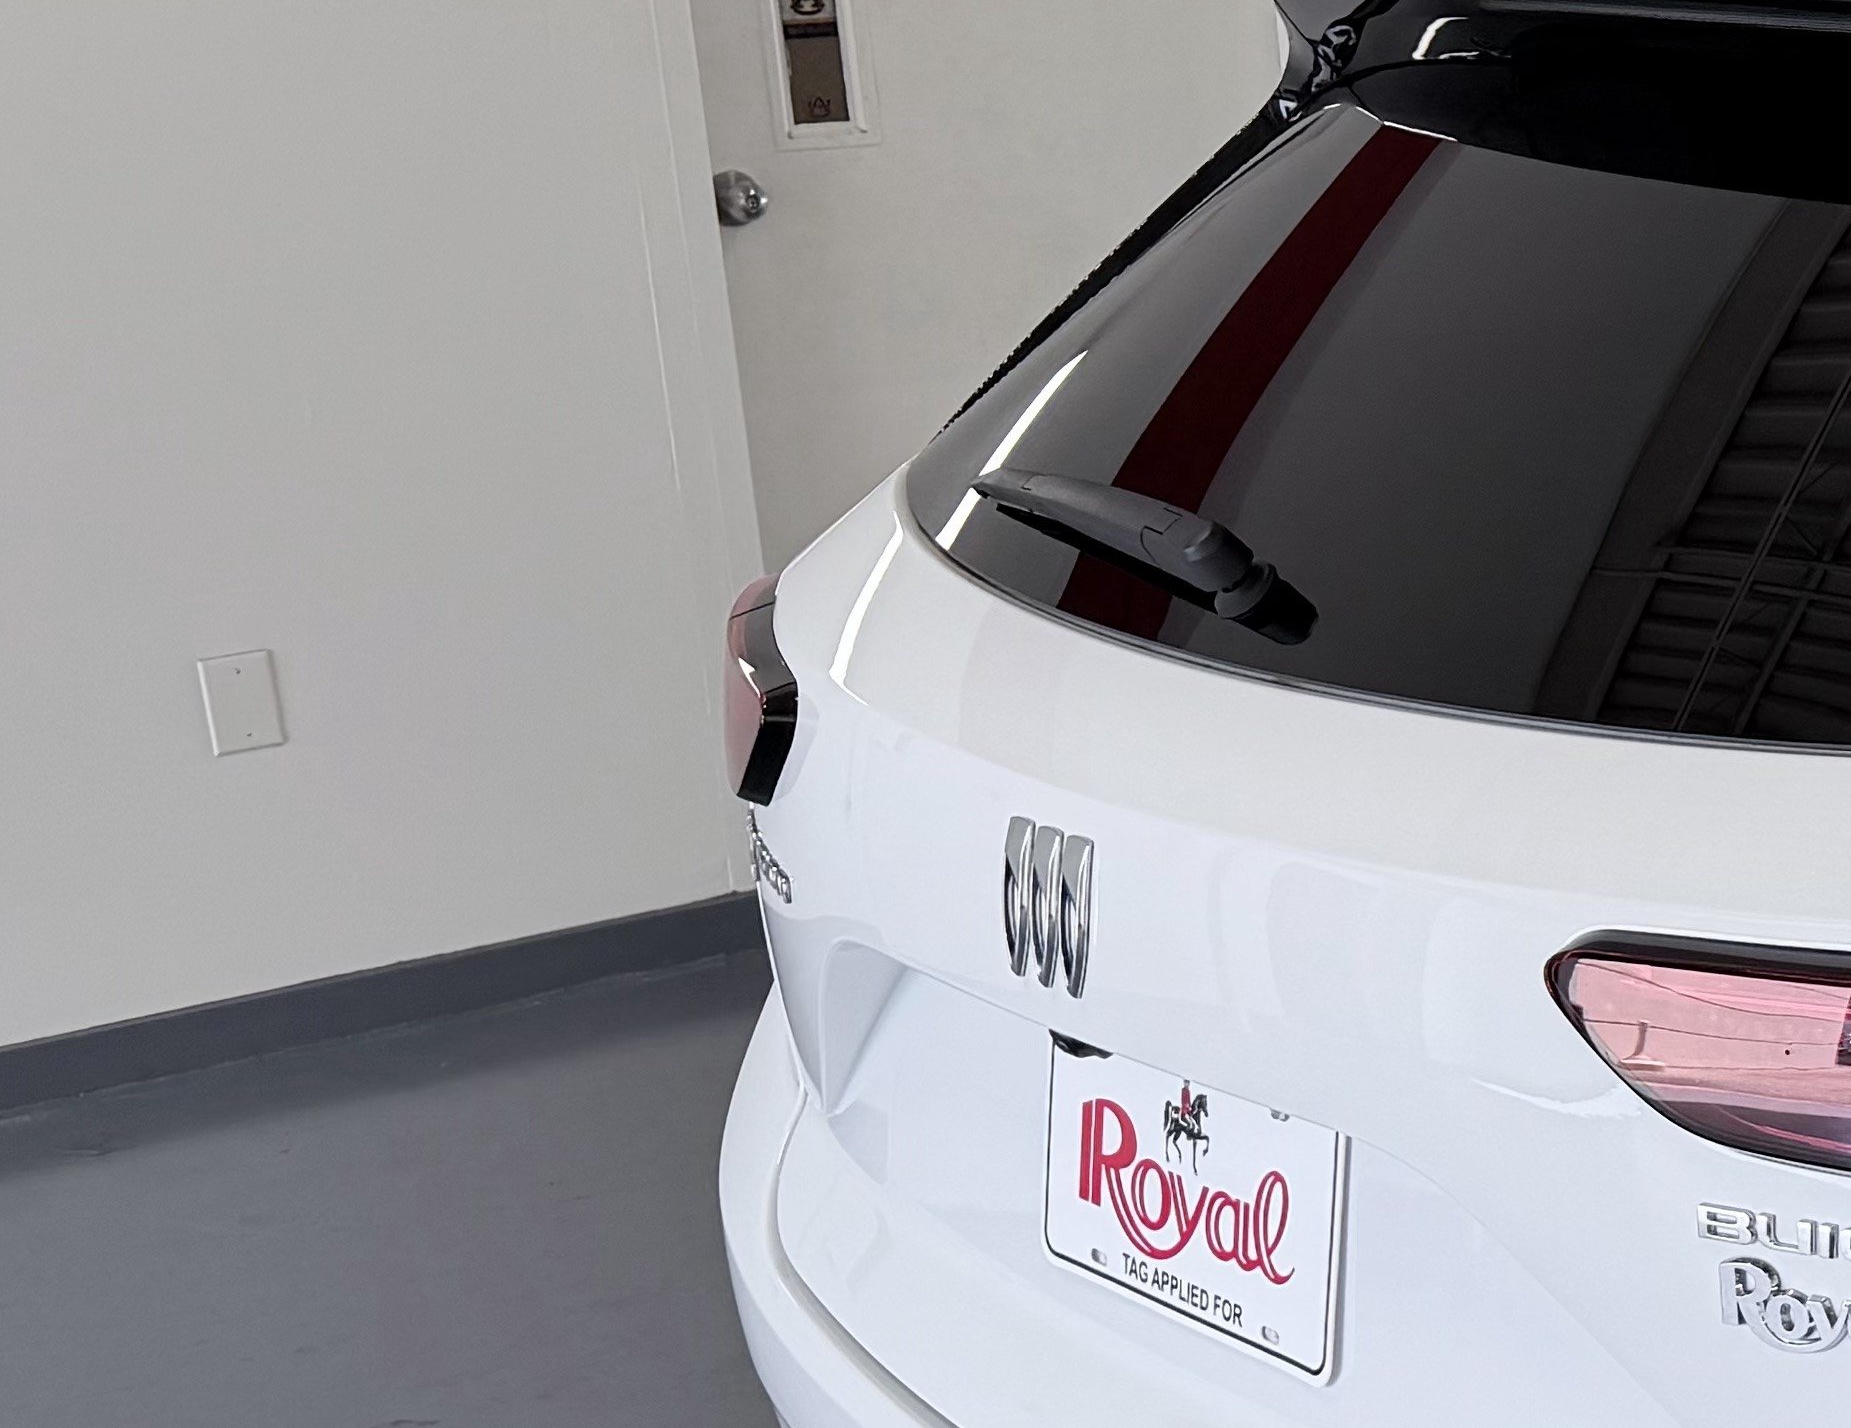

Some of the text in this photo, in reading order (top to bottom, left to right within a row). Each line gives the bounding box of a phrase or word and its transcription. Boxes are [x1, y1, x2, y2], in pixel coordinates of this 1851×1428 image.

[1078, 1098, 1295, 1286] Royal
[1122, 1252, 1243, 1327] TAG APPLIED FOR
